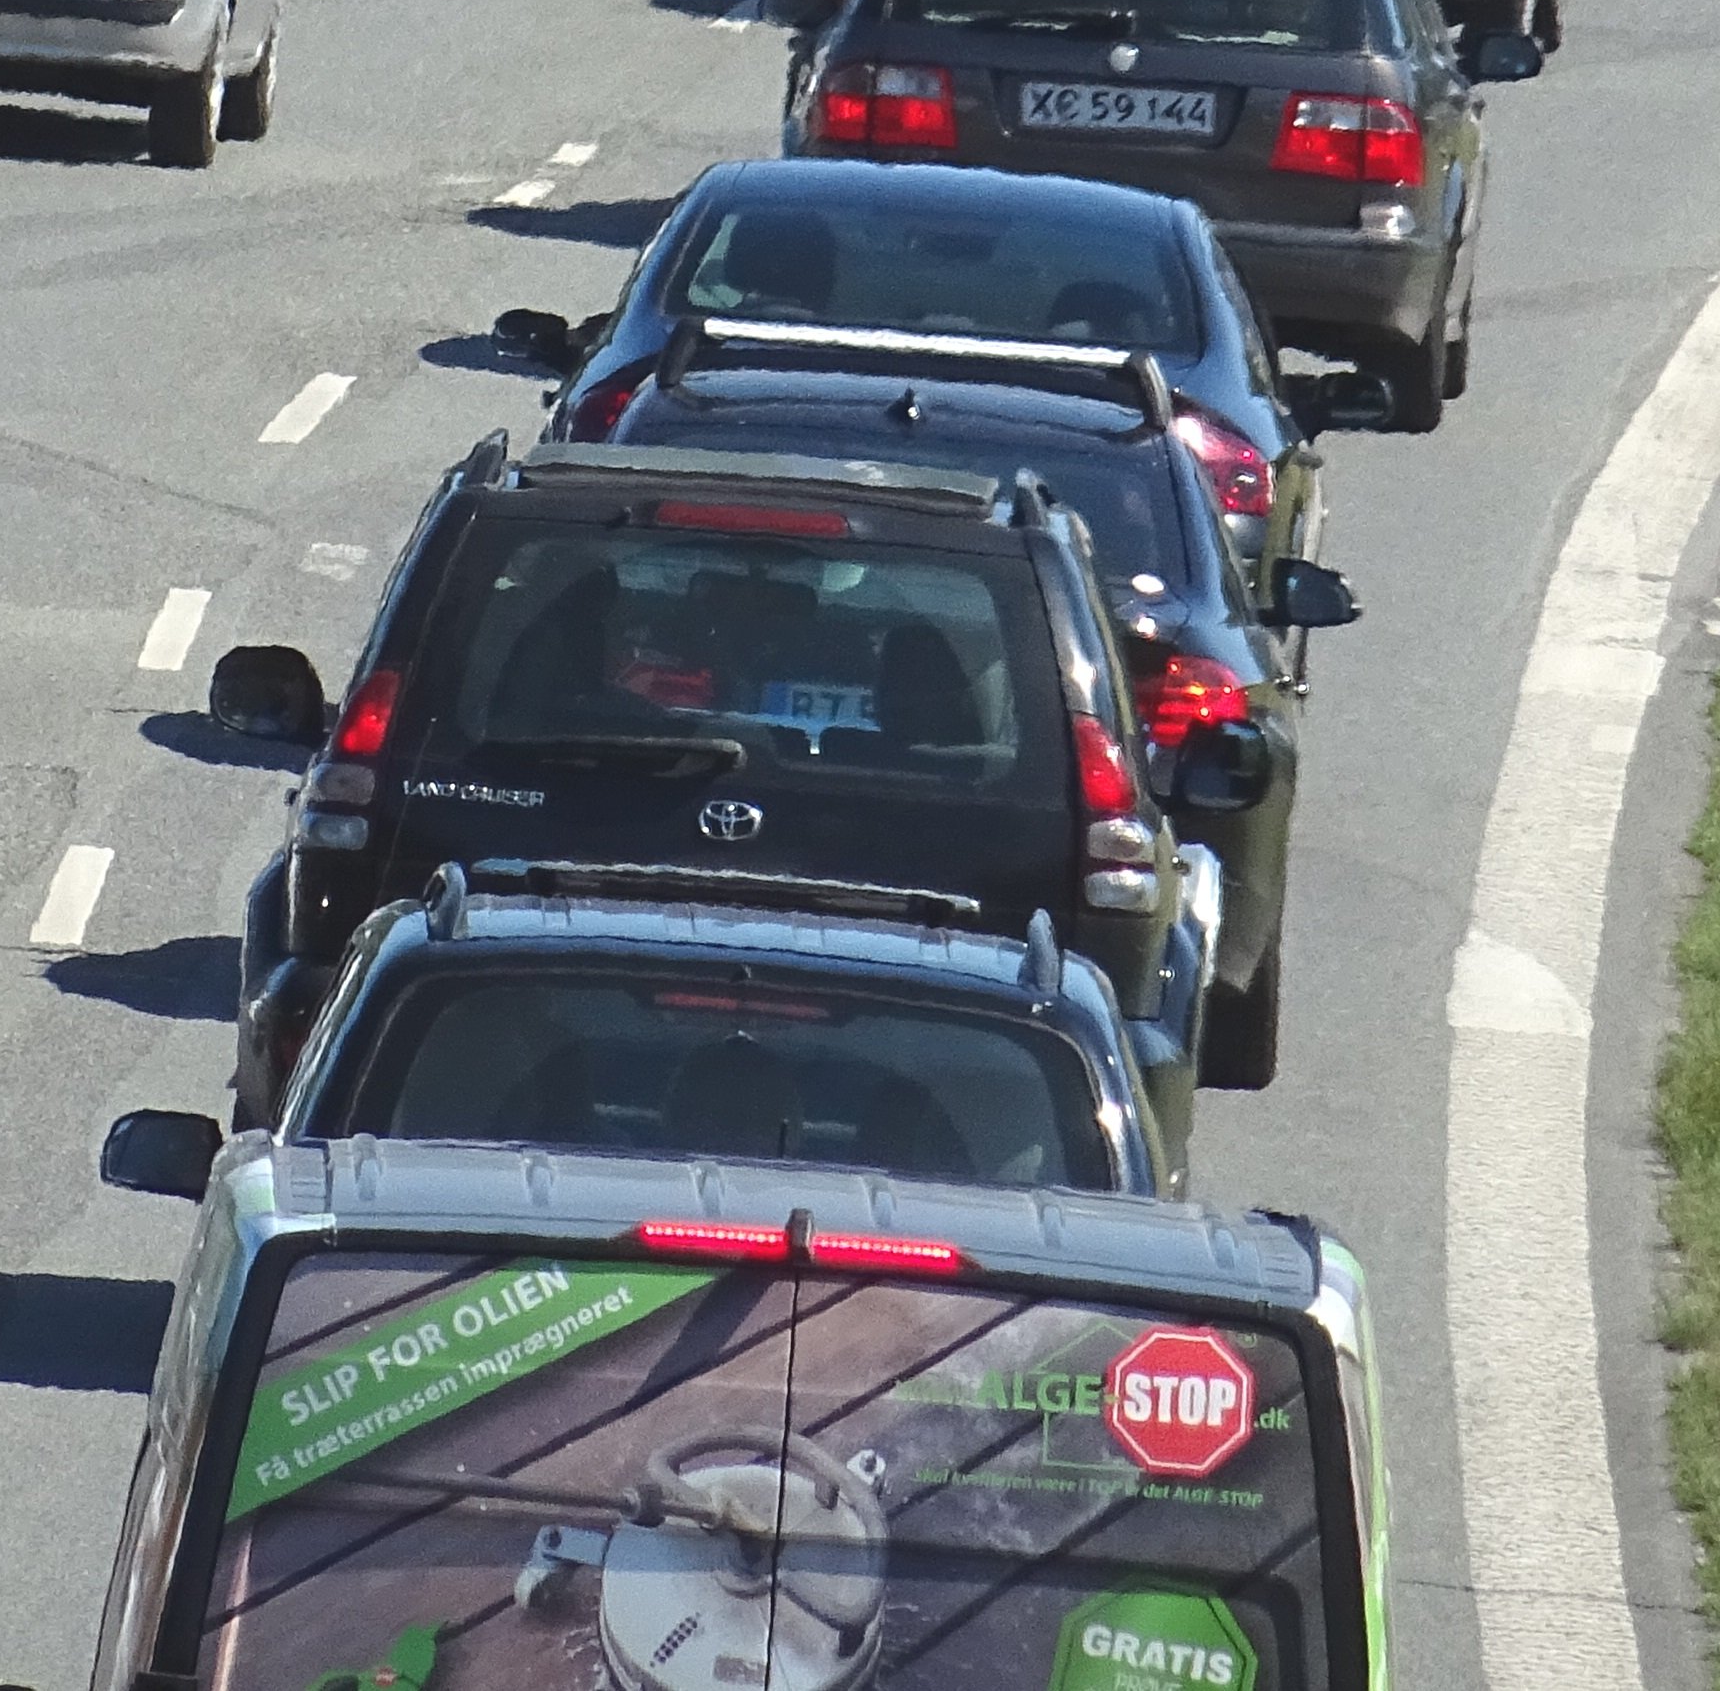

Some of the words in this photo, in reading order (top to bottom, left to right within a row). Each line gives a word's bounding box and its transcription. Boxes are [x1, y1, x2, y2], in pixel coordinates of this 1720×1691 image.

[1091, 90, 1137, 124] 59
[1147, 94, 1209, 128] 144
[402, 779, 457, 798] LAND
[459, 782, 546, 808] CRUISER
[281, 1364, 361, 1428] SLIP
[367, 1322, 450, 1383] FOR
[452, 1264, 570, 1339] OLIEN
[255, 1449, 291, 1488] Få
[293, 1373, 460, 1470] træterrassen
[459, 1284, 635, 1386] imprægneret
[1124, 1372, 1239, 1428] STOP
[1082, 1623, 1234, 1685] GRATIS
